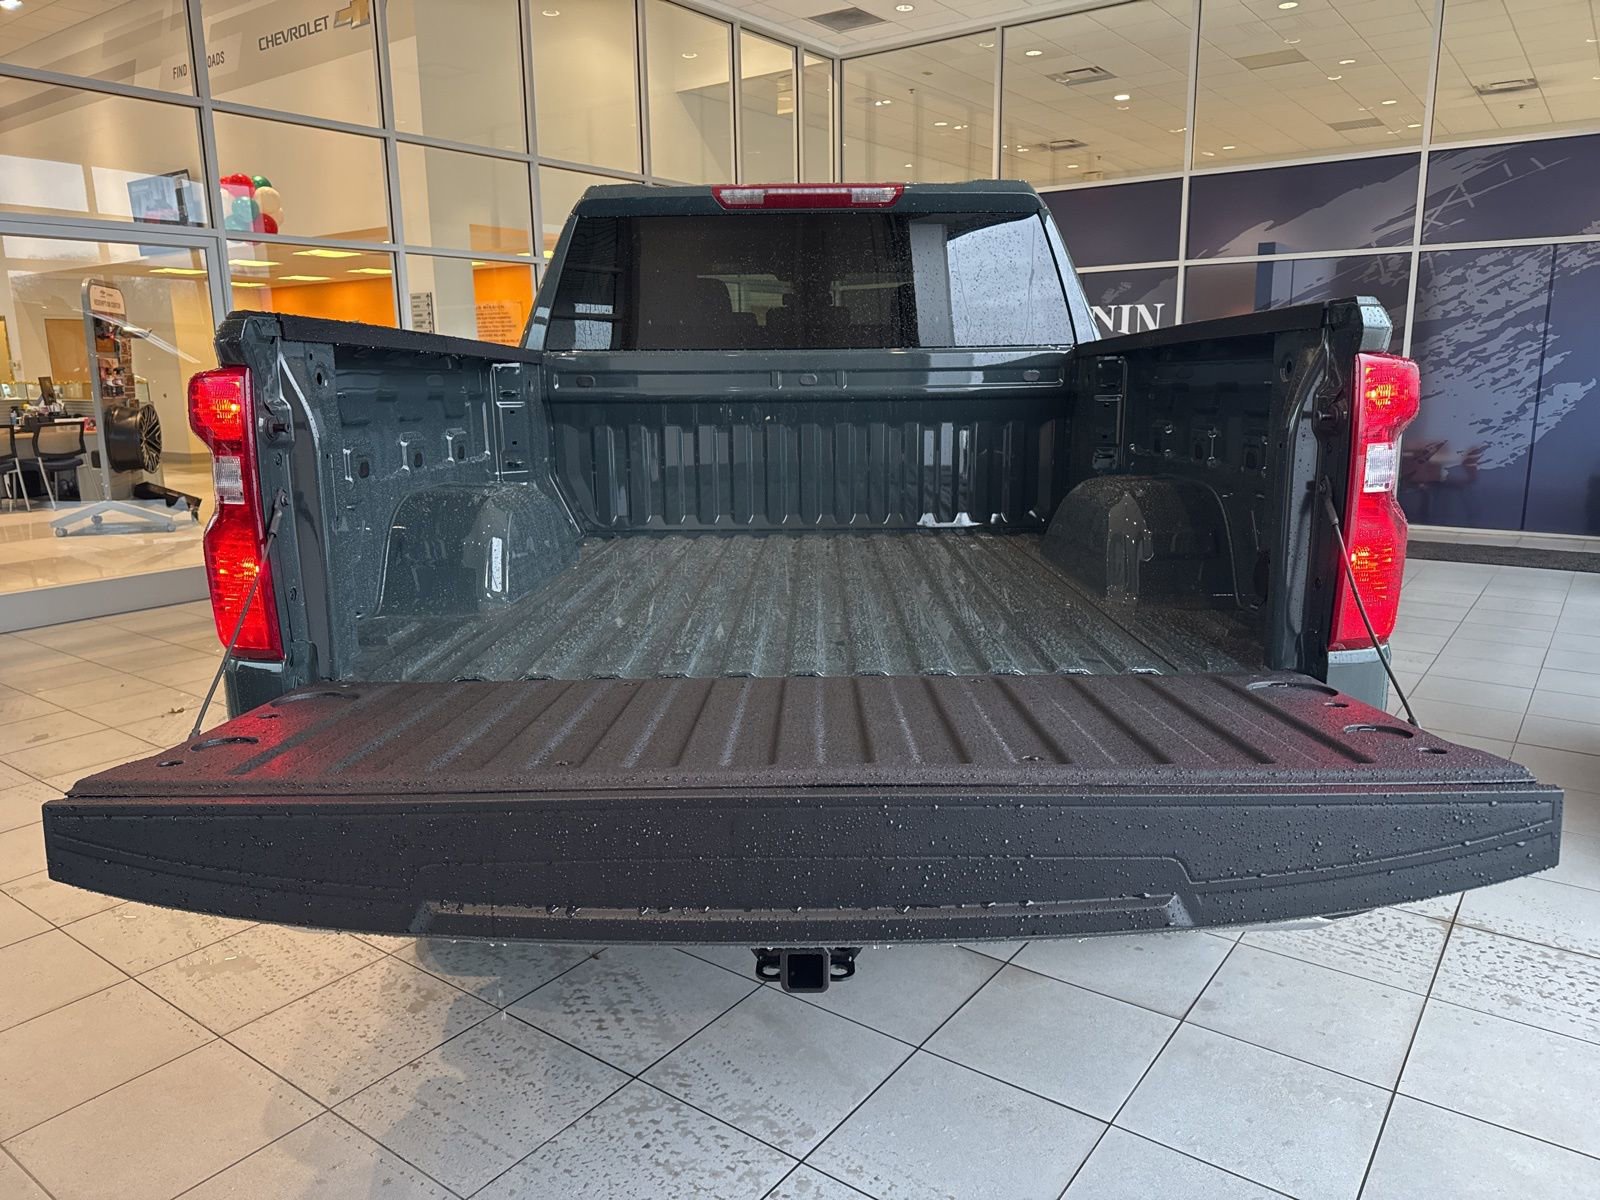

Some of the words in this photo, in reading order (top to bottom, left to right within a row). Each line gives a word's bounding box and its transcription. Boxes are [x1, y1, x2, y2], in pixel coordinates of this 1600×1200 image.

[258, 15, 330, 51] CHEVROLET
[172, 63, 188, 80] FIND
[207, 51, 225, 68] OADS
